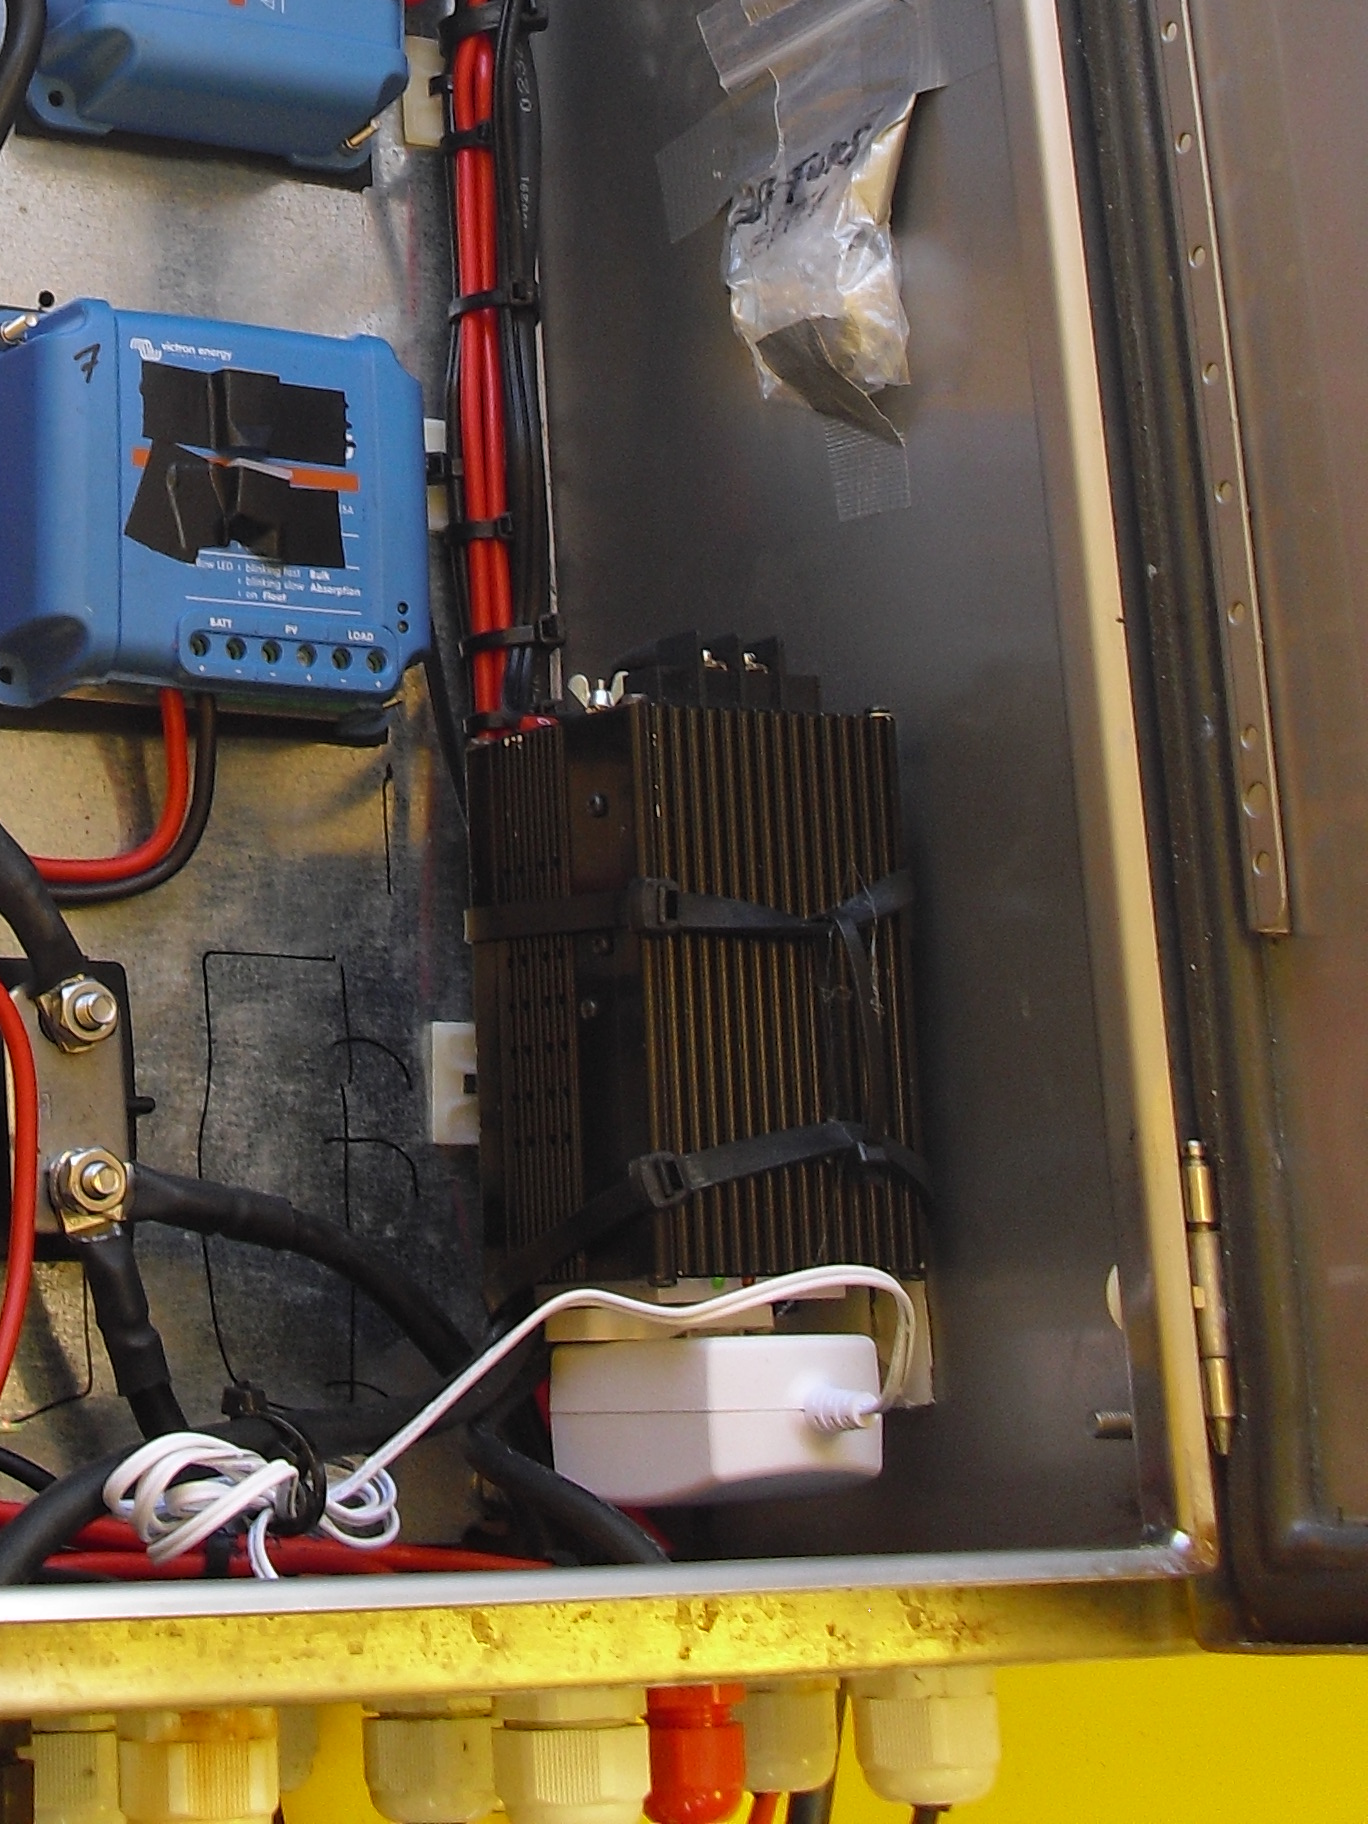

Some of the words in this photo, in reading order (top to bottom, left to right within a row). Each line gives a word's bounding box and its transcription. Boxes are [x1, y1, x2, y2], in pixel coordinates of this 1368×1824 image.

[161, 342, 195, 355] victron
[197, 347, 232, 360] energy
[209, 617, 232, 629] BATT
[284, 624, 298, 635] PV
[347, 630, 374, 642] LOAD
